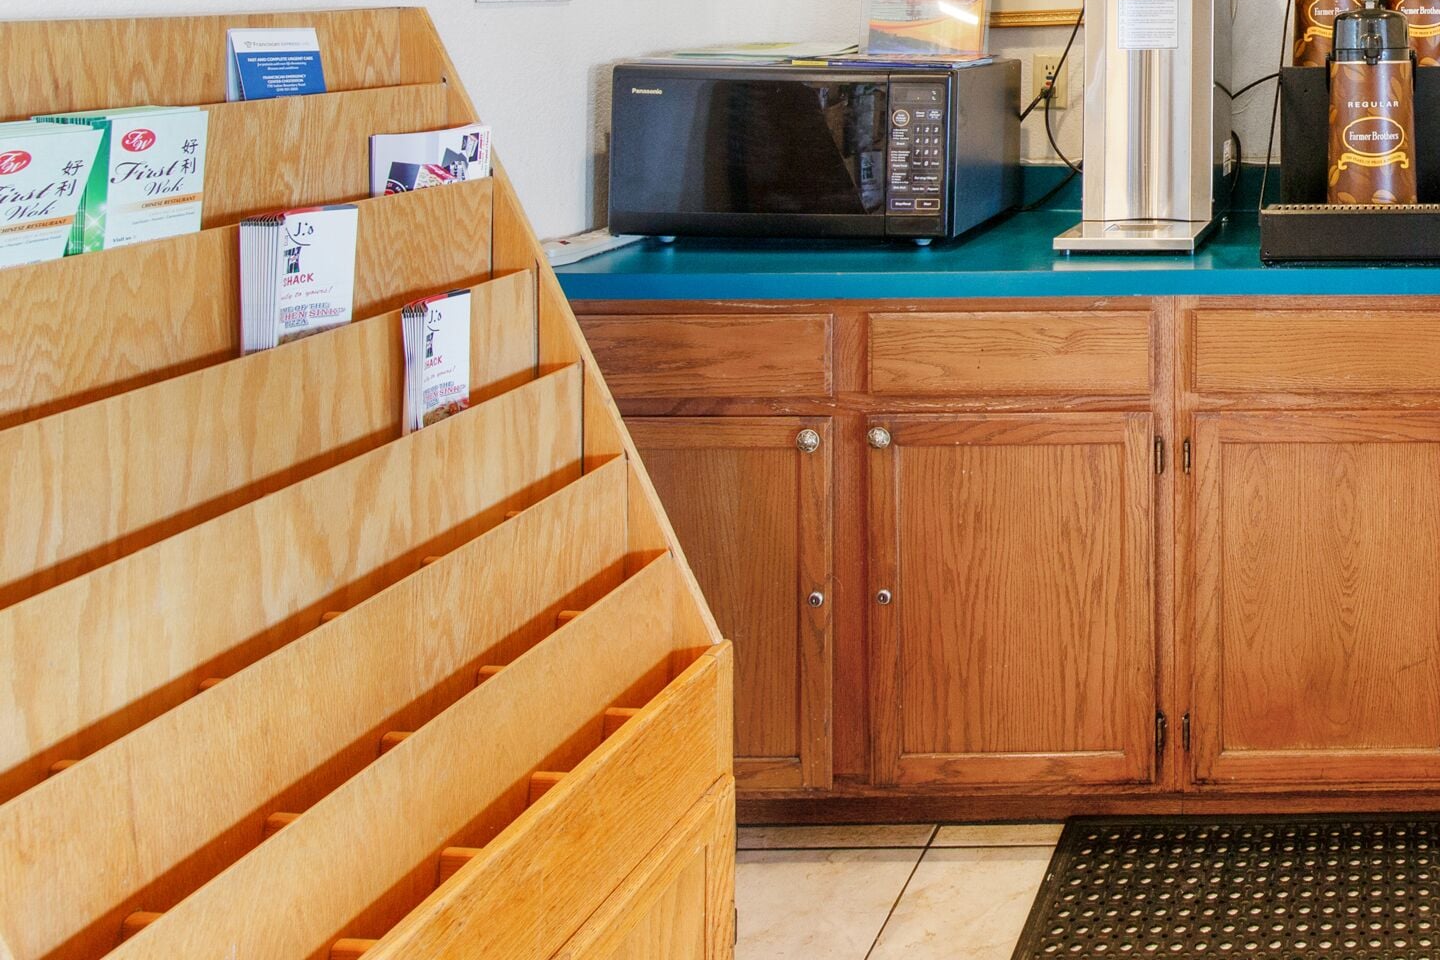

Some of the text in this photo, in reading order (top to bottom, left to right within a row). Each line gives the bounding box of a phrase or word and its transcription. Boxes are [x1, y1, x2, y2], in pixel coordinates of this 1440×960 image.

[1314, 8, 1334, 16] Farmer
[631, 87, 663, 95] Panasonic
[1349, 131, 1399, 141] Farmer Brothers
[181, 138, 199, 175] 好利
[56, 159, 84, 197] 好利
[110, 159, 179, 184] First
[144, 177, 184, 196] Wok
[141, 195, 197, 209] CHINESE RESTAURANT
[4, 199, 57, 221] Wok
[26, 219, 67, 231] RESTAURANT
[283, 273, 314, 287] SHACK
